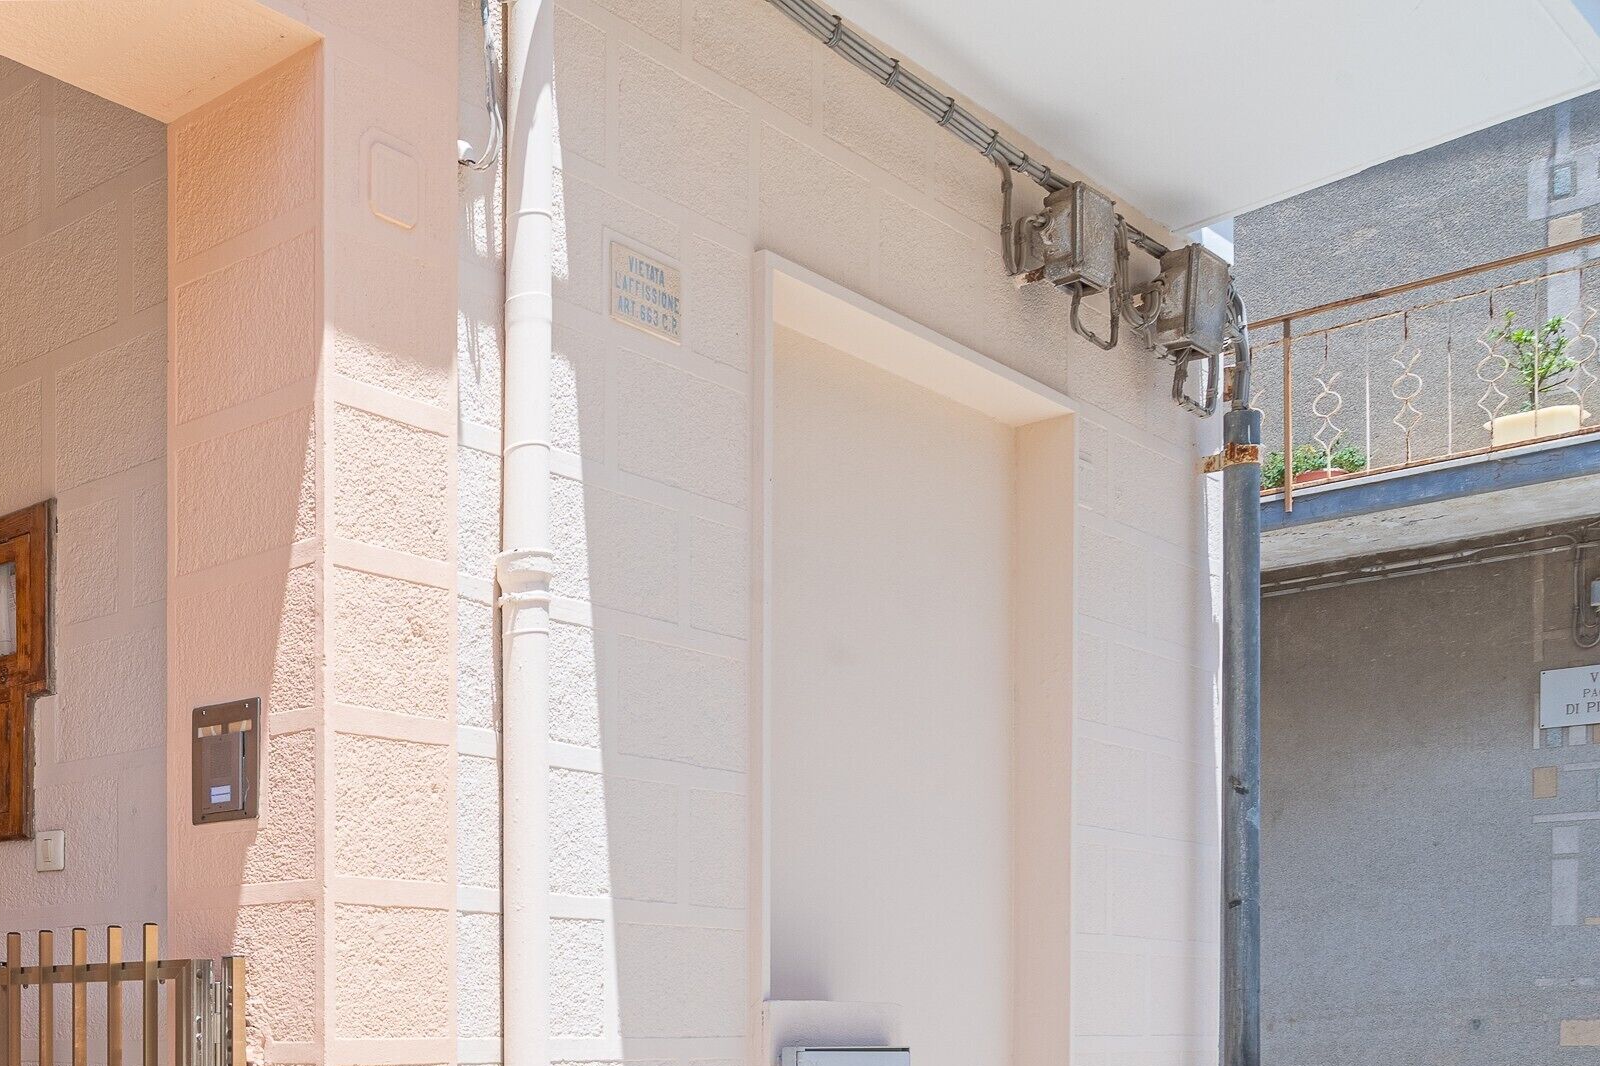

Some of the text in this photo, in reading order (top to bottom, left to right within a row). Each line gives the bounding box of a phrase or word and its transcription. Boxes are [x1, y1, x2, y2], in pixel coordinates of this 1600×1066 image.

[628, 255, 665, 288] VIETATA
[640, 304, 659, 327] 663
[1583, 687, 1600, 698] PA
[1566, 703, 1579, 715] DI
